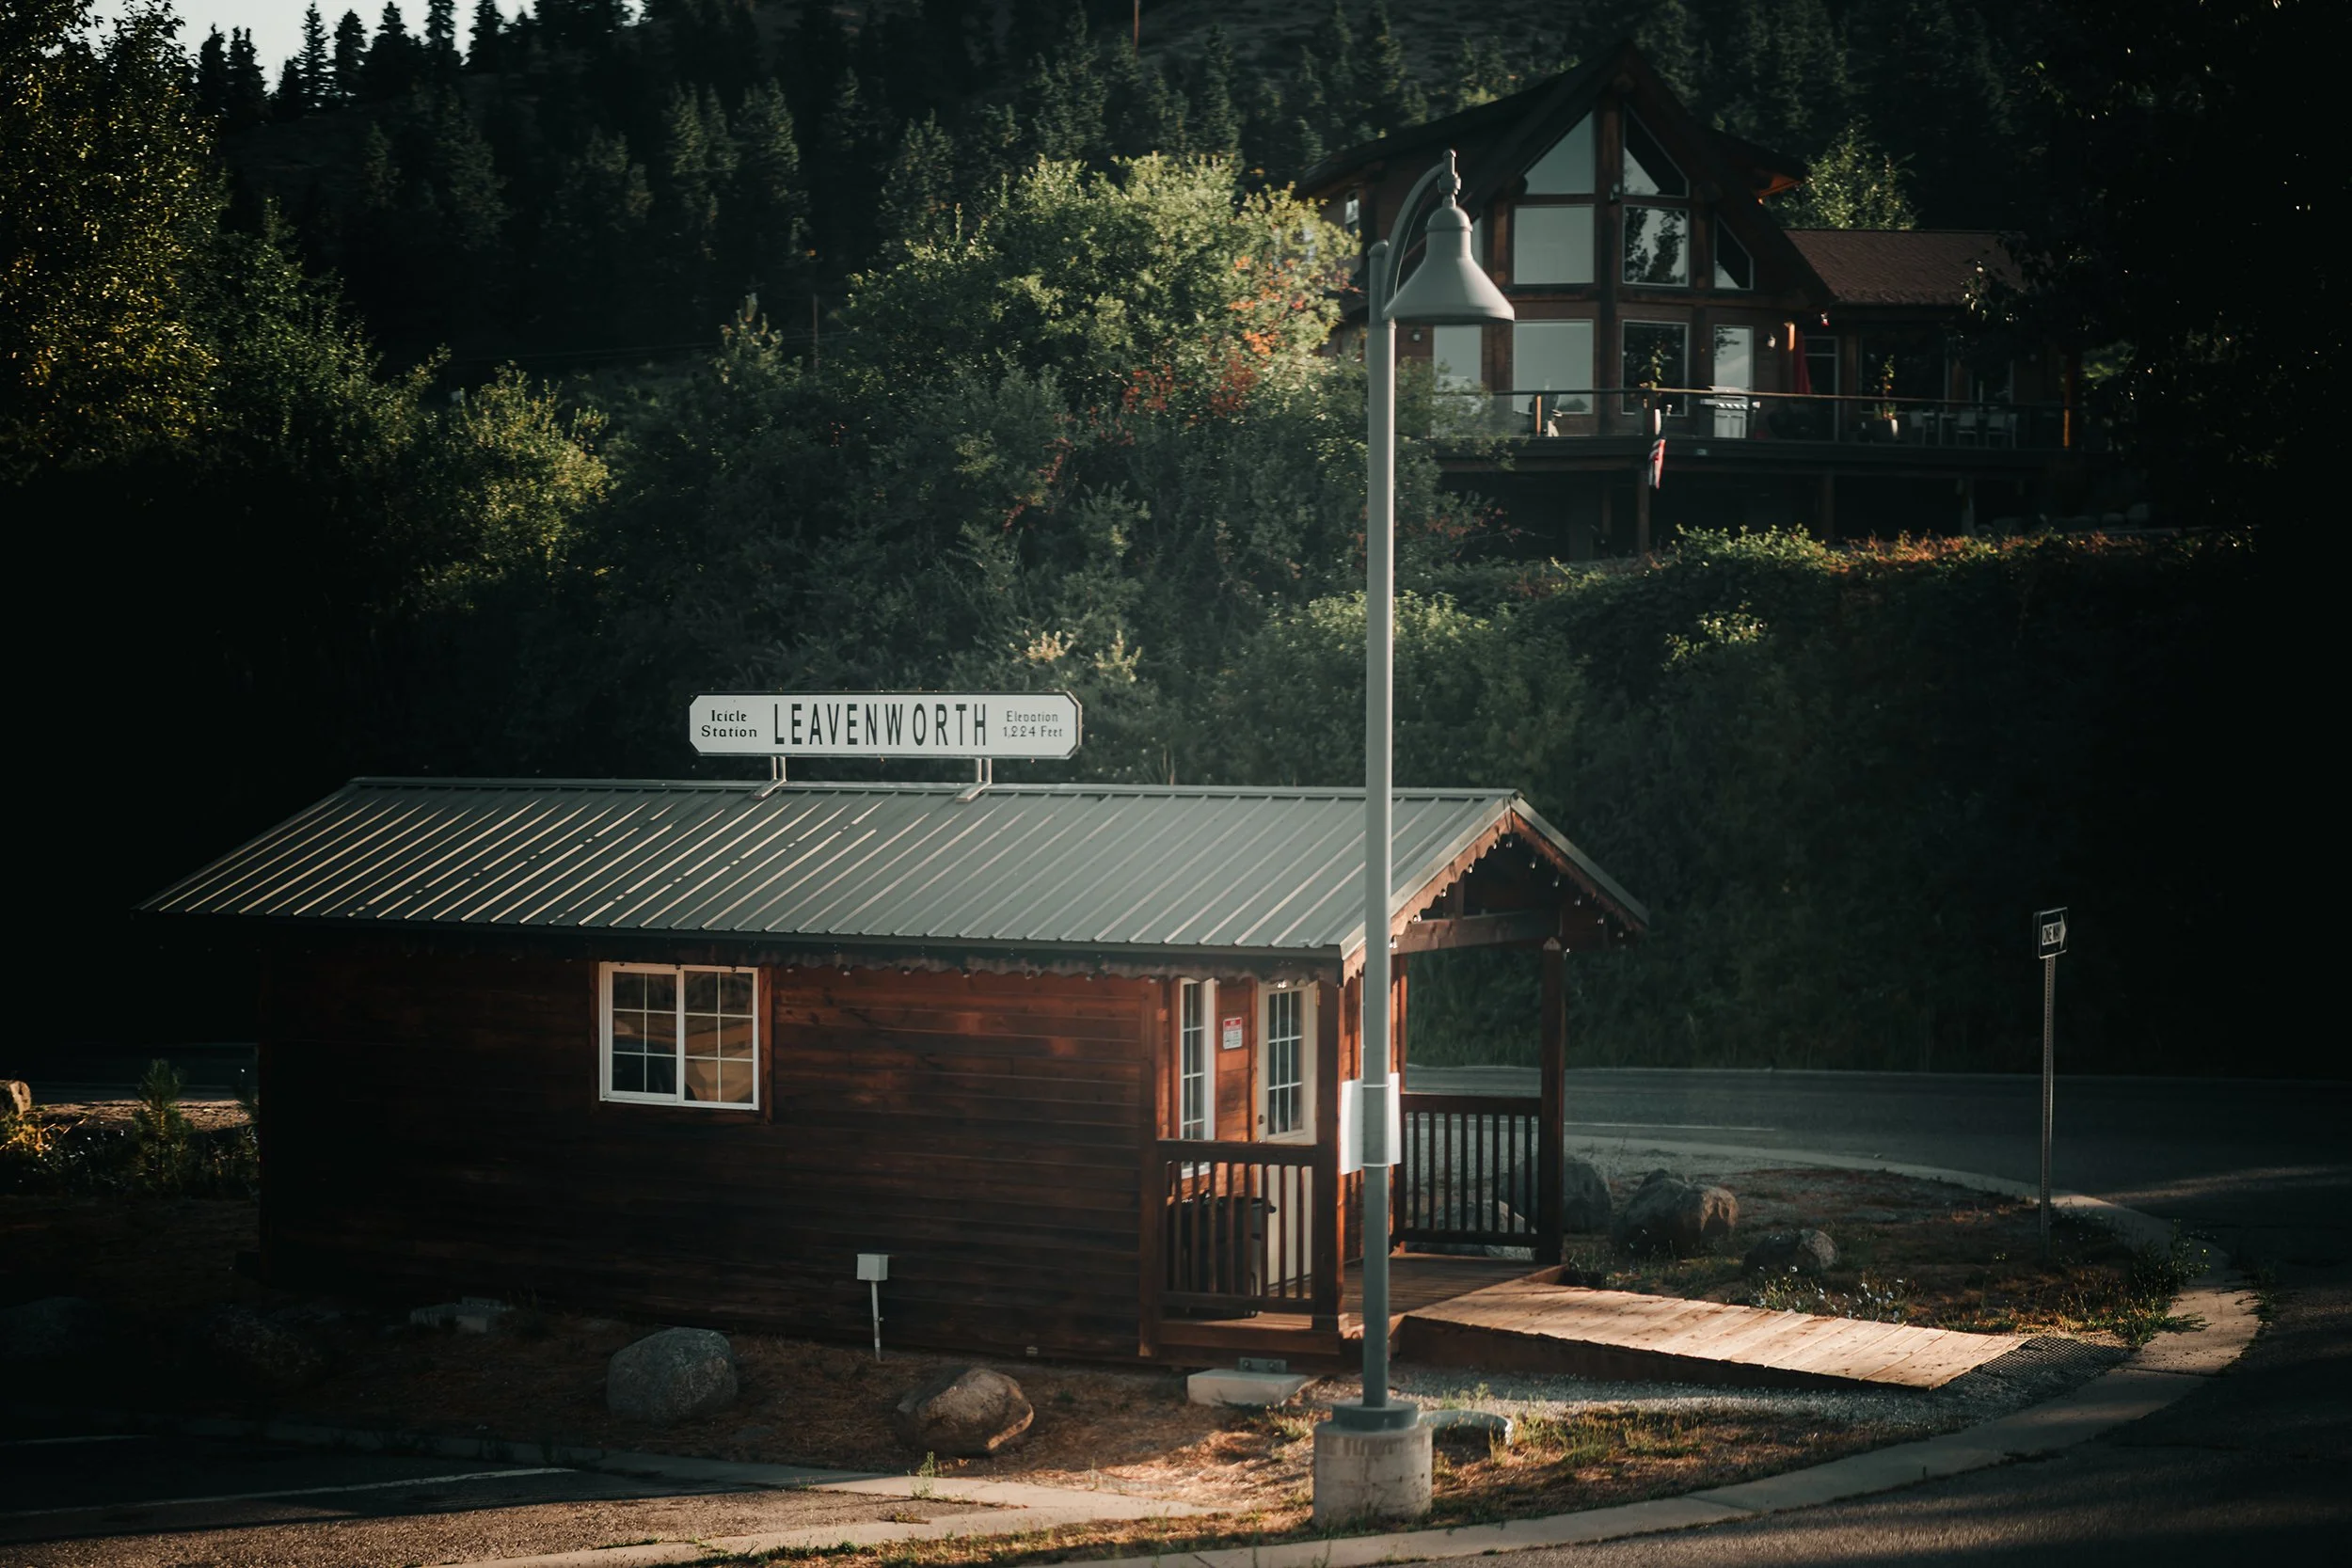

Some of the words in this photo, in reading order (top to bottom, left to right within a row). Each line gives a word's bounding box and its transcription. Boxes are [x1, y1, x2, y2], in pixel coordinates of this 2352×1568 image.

[710, 709, 747, 722] Icicle
[1006, 709, 1058, 722] Elevation
[701, 724, 757, 738] Station
[774, 703, 986, 747] LEAVENWORTH
[1003, 725, 1037, 738] 1,224
[1040, 725, 1063, 738] Feet
